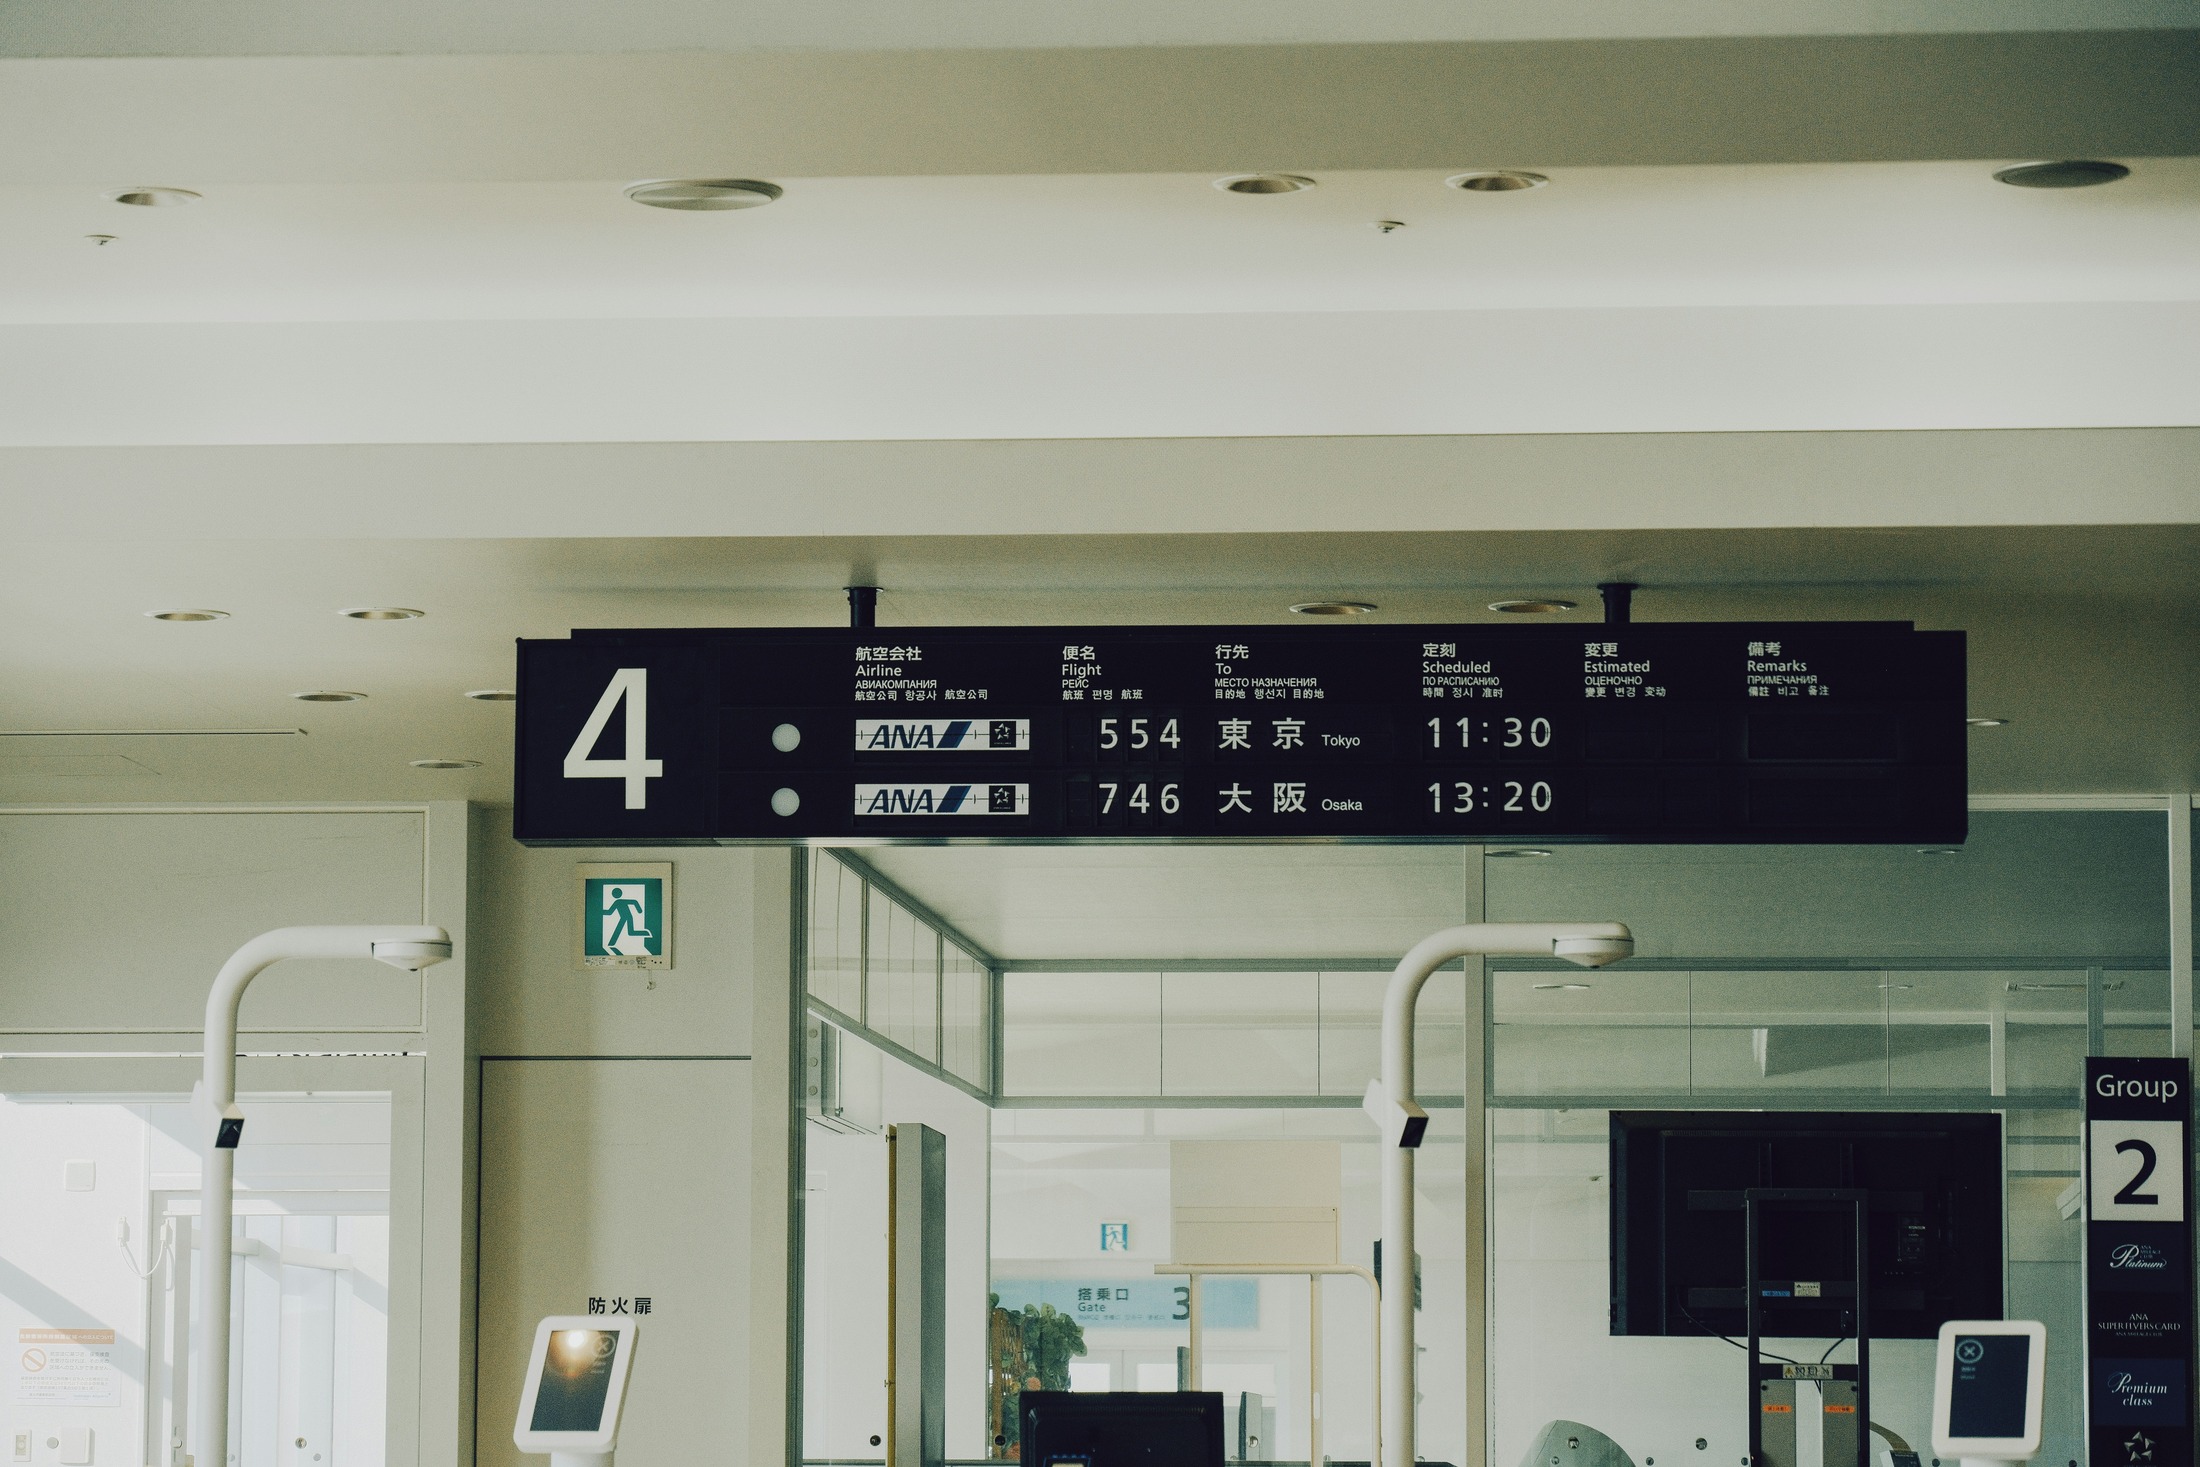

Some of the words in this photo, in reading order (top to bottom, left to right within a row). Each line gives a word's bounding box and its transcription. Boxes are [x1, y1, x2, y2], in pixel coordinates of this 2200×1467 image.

[856, 646, 922, 661] 航空会社
[1063, 646, 1095, 660] 便名
[1216, 645, 1249, 659] 行先
[1423, 643, 1455, 657] 定刻
[1585, 643, 1618, 657] 変更
[1748, 642, 1781, 656] 備考
[855, 664, 902, 677] Airline
[1062, 663, 1101, 678] Flight
[1214, 663, 1232, 675] To
[1422, 661, 1491, 674] Scheduled
[1584, 660, 1650, 673] Estimated
[1747, 660, 1808, 672] Remarks
[854, 679, 937, 690] АВИАКОМПАНИЯ
[1061, 678, 1090, 689] РЕЙС
[1214, 677, 1250, 688] МЕСТО
[1251, 677, 1317, 688] НАЗНАЧЕНИЯ
[1422, 676, 1437, 686] ПО
[1437, 676, 1500, 686] РАСПИСАНИЮ
[1584, 676, 1643, 687] ОЦЕНОЧНО
[1747, 674, 1818, 685] ПРИМЕЧАНИЯ
[854, 691, 898, 702] 航空公司
[904, 690, 937, 702] 항공사
[944, 689, 988, 701] 航空公司
[1062, 690, 1084, 701] 航班
[1092, 690, 1113, 701] 편명
[1120, 689, 1143, 700] 航班
[1215, 689, 1246, 700] 目的地
[1254, 688, 1286, 700] 행선지
[1293, 689, 1325, 700] 目的地
[1422, 687, 1444, 698] 時間
[1452, 688, 1473, 699] 정시
[1614, 687, 1636, 698] 변경
[1777, 686, 1799, 697] 비고
[564, 668, 662, 809] 4
[868, 725, 934, 748] ANA
[1101, 719, 1180, 749] 554
[1218, 717, 1305, 749] 東京
[1322, 735, 1360, 748] Tokyo
[1428, 718, 1550, 747] 11:30
[867, 789, 934, 813] ANA
[1099, 783, 1179, 813] 746
[1219, 783, 1306, 813] 大阪
[1321, 799, 1363, 811] Osaka
[1429, 782, 1551, 813] 13:20
[2096, 1075, 2177, 1103] Group
[2114, 1139, 2158, 1205] 2
[2109, 1243, 2167, 1268] Platinum
[1077, 1288, 1129, 1301] 搭乗口
[589, 1297, 651, 1314] 防火扉
[1077, 1302, 1106, 1313] Gate
[1173, 1287, 1189, 1320] 3
[2129, 1313, 2149, 1321] ANA
[2098, 1322, 2124, 1330] SUPER
[2154, 1322, 2181, 1331] CARD
[2108, 1371, 2167, 1393] Premium
[2122, 1394, 2153, 1406] class
